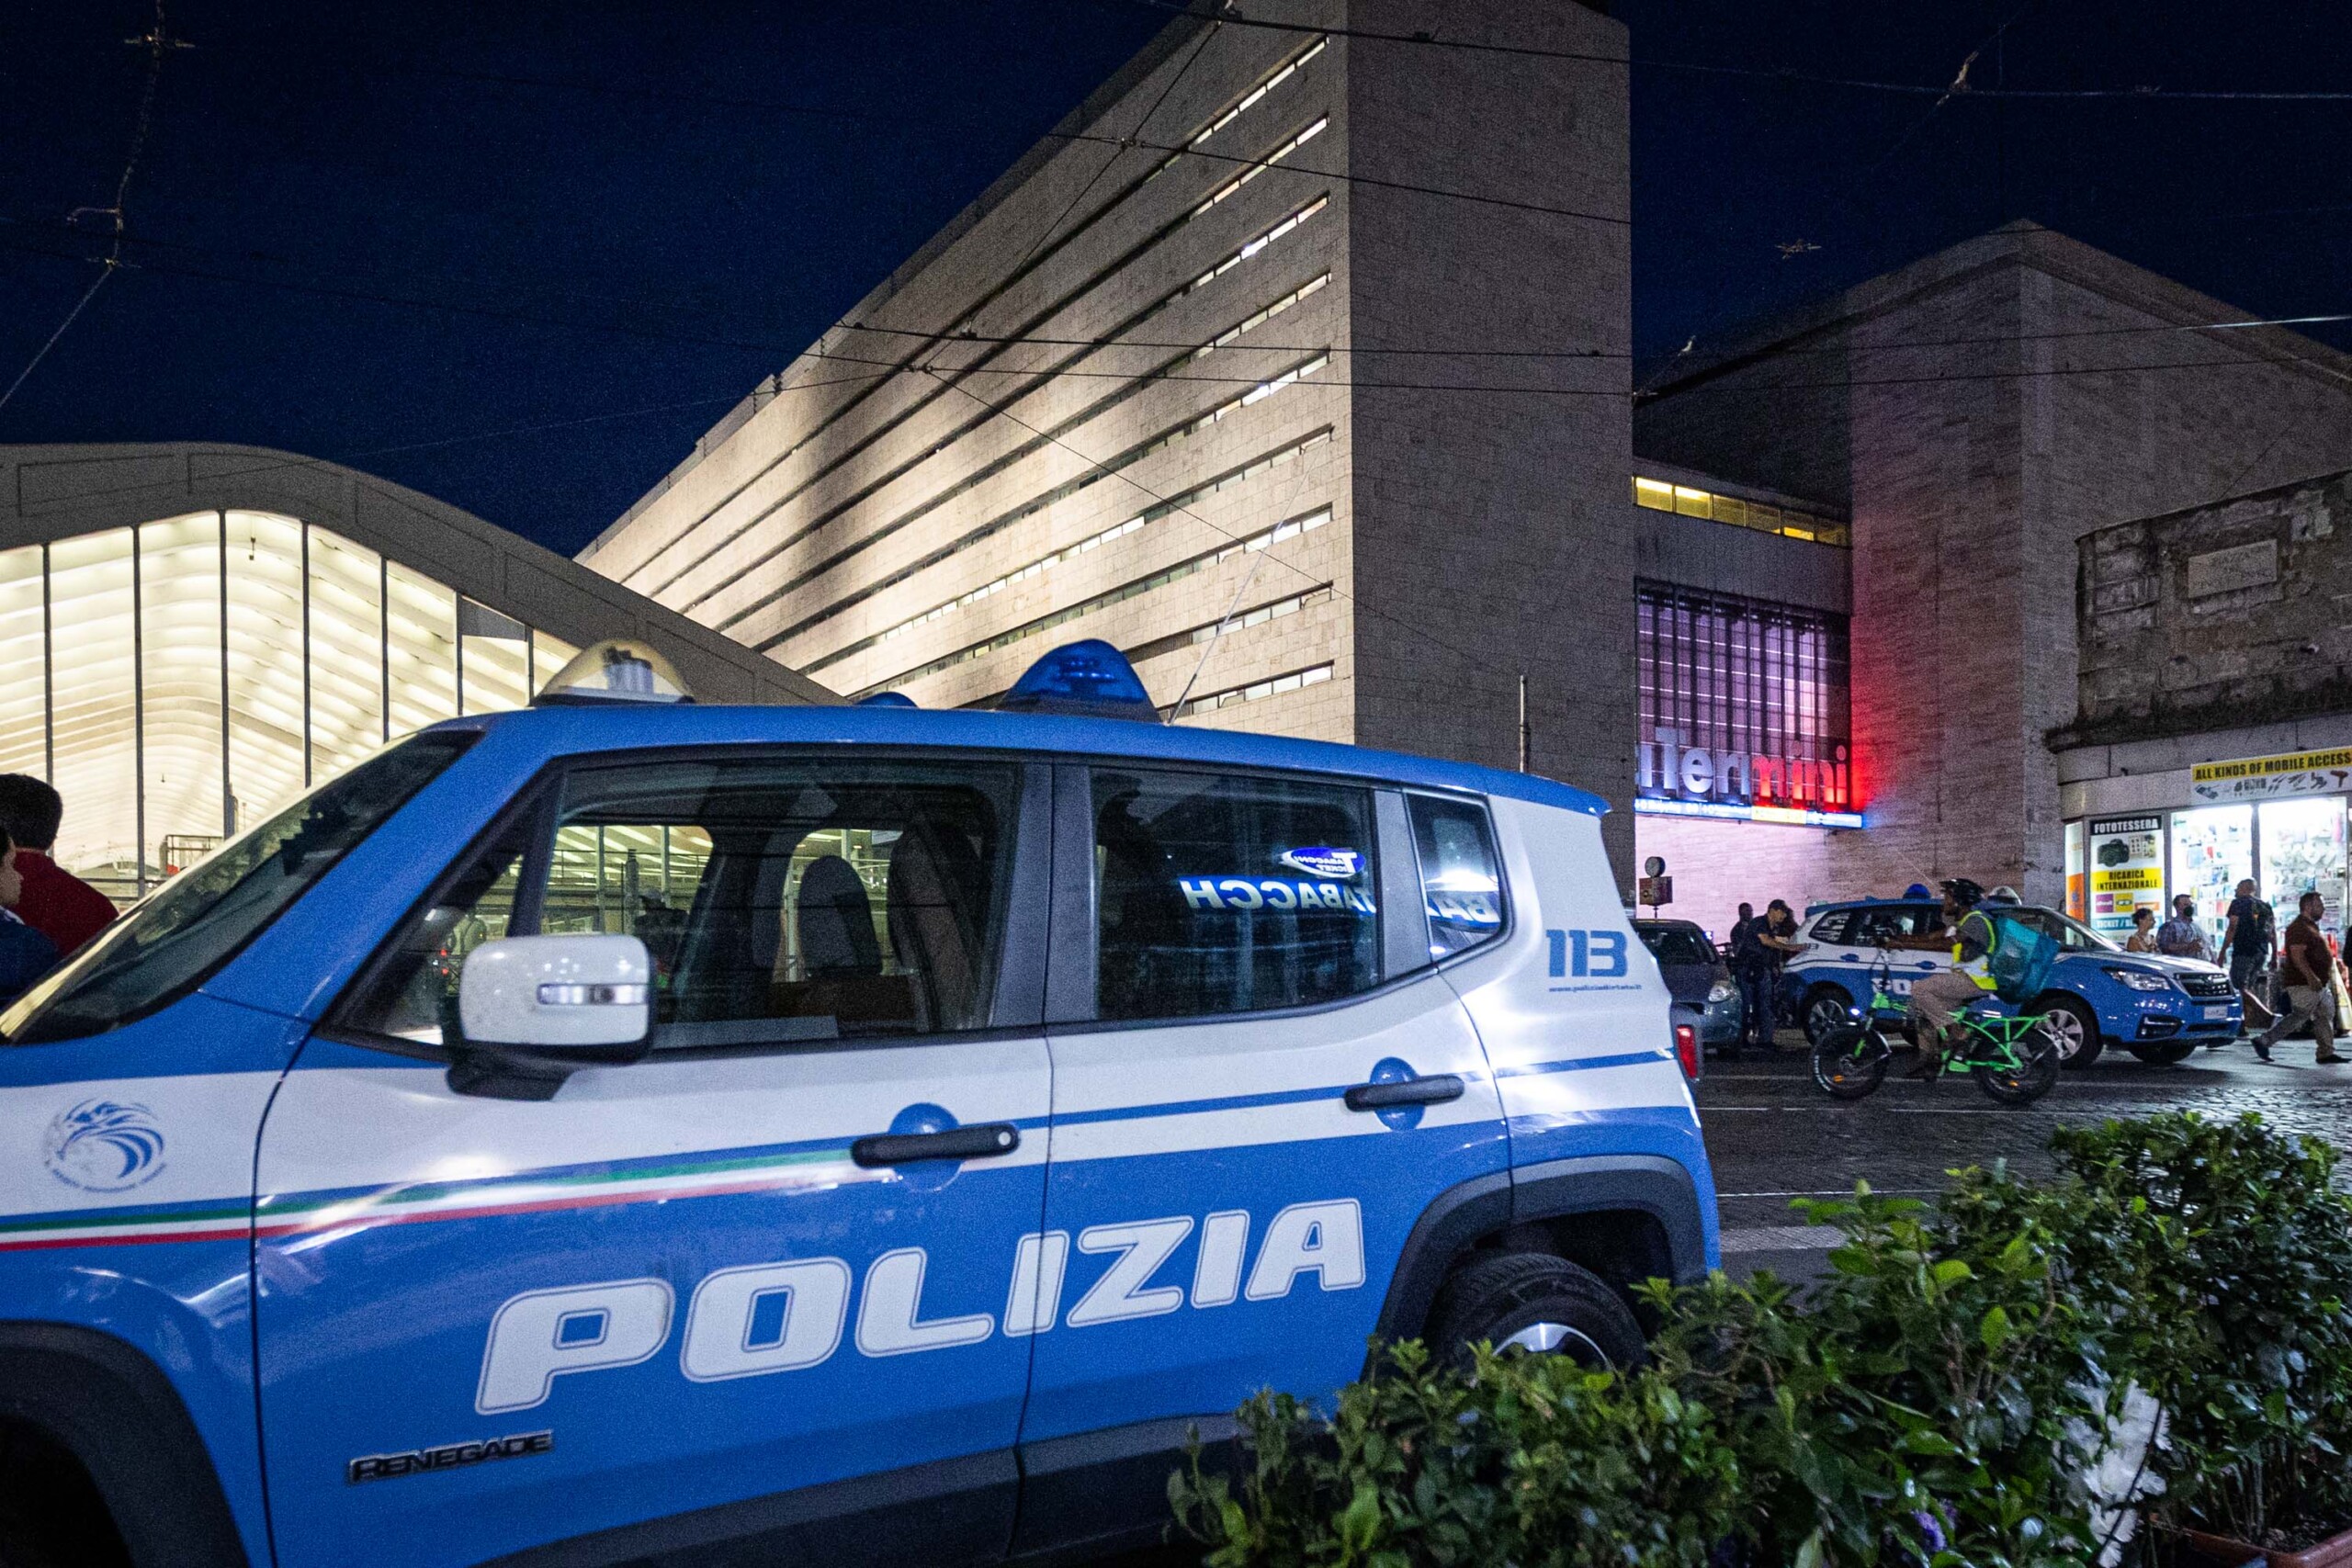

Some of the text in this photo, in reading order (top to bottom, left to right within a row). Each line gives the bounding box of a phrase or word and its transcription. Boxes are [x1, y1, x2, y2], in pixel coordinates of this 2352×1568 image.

[1655, 726, 1848, 804] Termini
[2195, 768, 2212, 780] ALL
[2215, 764, 2246, 778] KINDS
[2249, 761, 2261, 774] OF
[2265, 757, 2304, 773] MOBILE
[2095, 818, 2159, 834] FOTOTESSERA
[2097, 879, 2158, 891] INTERNAZIONALE
[2109, 870, 2144, 880] RICARICA
[1546, 930, 1627, 976] 113
[474, 1197, 1365, 1416] POLIZIA
[349, 1429, 553, 1484] RENEGADE
